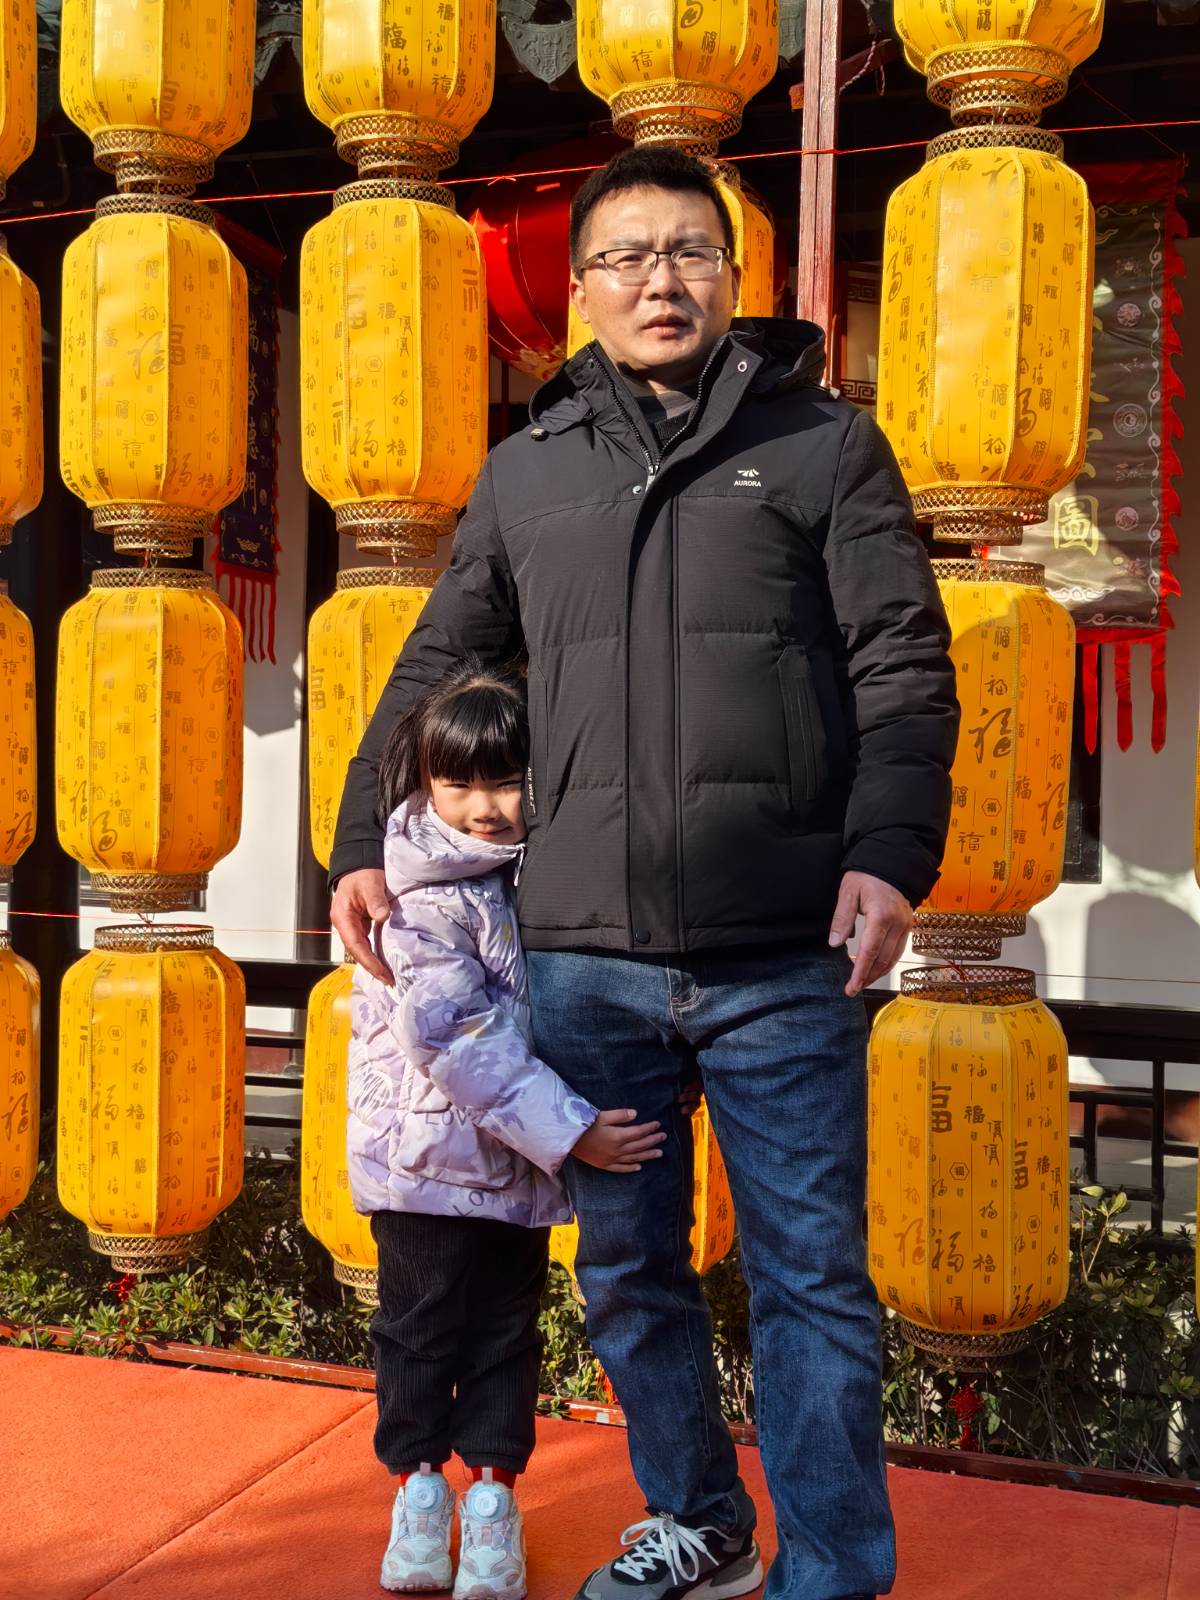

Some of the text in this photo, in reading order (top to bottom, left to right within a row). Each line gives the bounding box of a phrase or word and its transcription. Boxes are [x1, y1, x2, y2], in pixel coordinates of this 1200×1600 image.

[384, 22, 407, 49] 福
[632, 50, 653, 71] 福
[379, 302, 397, 320] 福
[464, 344, 478, 362] 福
[387, 438, 407, 457] 福
[1054, 496, 1098, 556] 圖
[163, 645, 184, 666] 福
[1015, 775, 1032, 800] 福
[958, 832, 984, 853] 福
[162, 991, 181, 1014] 福
[126, 1104, 145, 1119] 福
[964, 1105, 984, 1124] 福
[972, 1254, 996, 1273] 福
